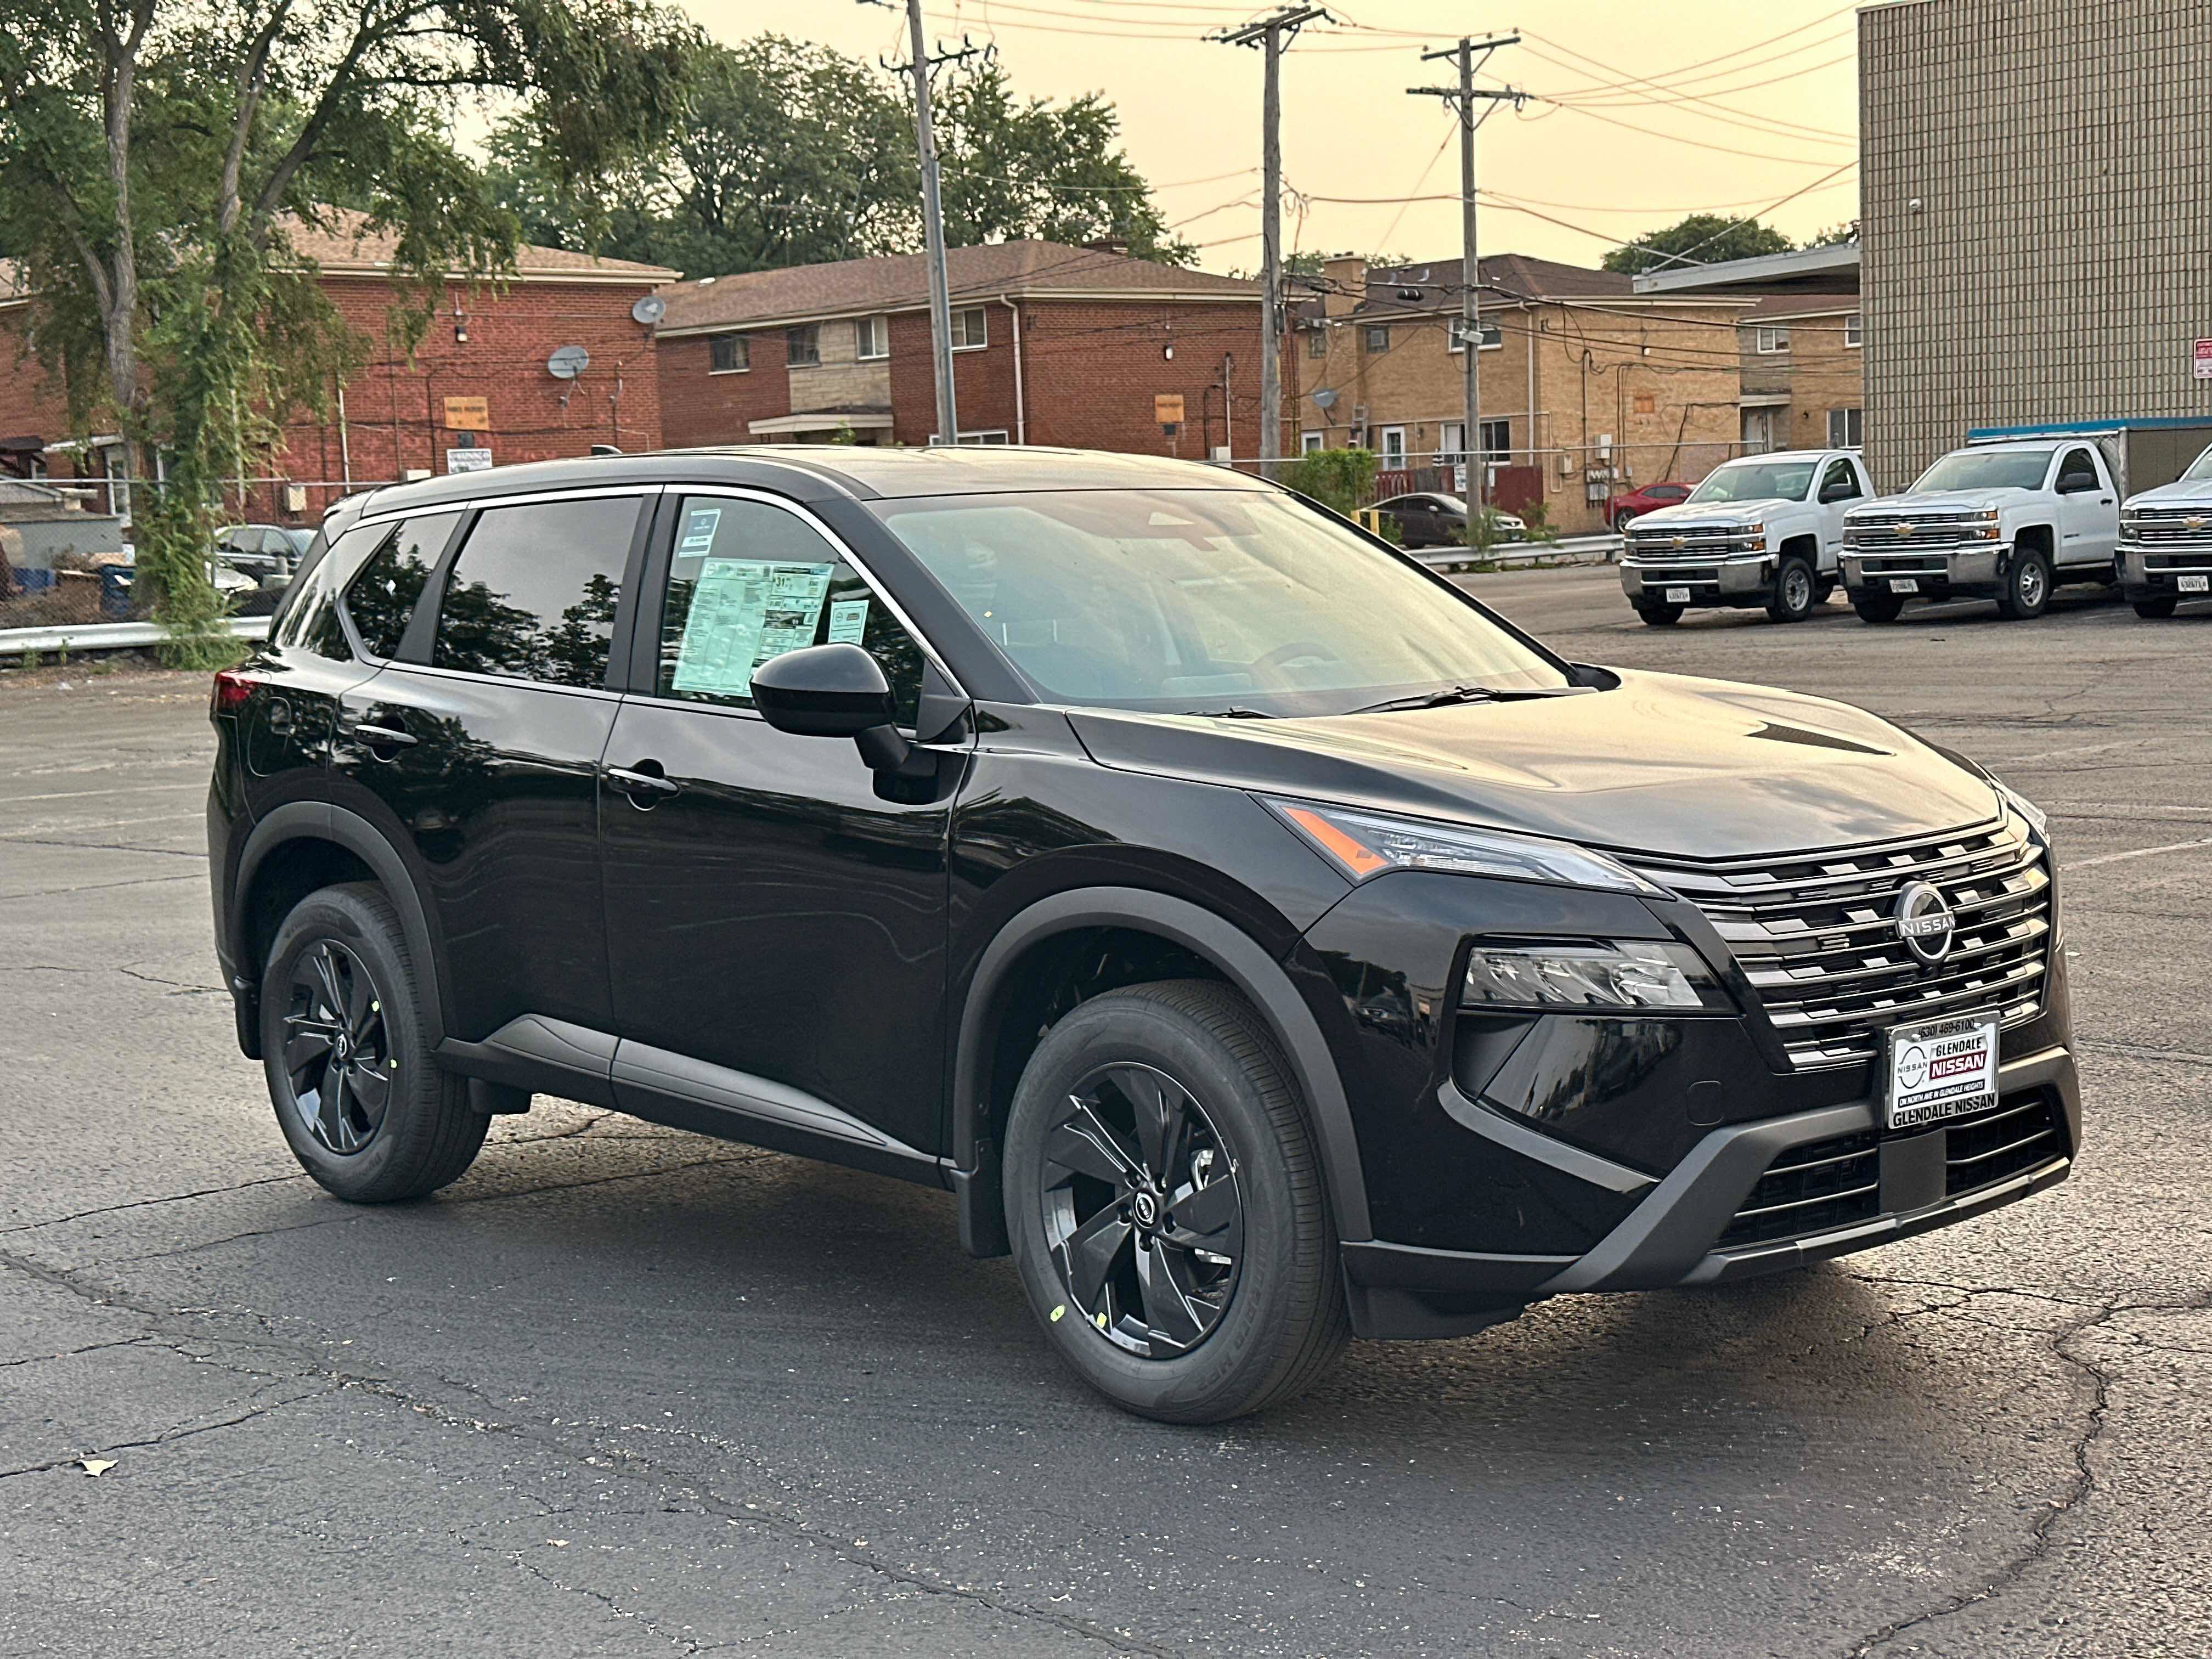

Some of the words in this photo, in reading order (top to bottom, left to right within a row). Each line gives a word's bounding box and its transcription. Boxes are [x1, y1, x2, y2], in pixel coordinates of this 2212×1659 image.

[1901, 916, 1955, 935] NISSAN
[1939, 1018, 1974, 1034] 469-6100
[1936, 1037, 1982, 1057] GLENDALE
[1898, 1062, 1928, 1074] NISSAN
[1932, 1053, 1984, 1077] NISSAN
[1899, 1098, 1907, 1106] ON
[1907, 1094, 1922, 1104] NORTH
[1939, 1085, 1963, 1097] GLENDALE
[1963, 1081, 1984, 1091] HEIGHTS
[1893, 1102, 1952, 1127] GLENDALE
[1955, 1093, 1995, 1114] NISSAN
